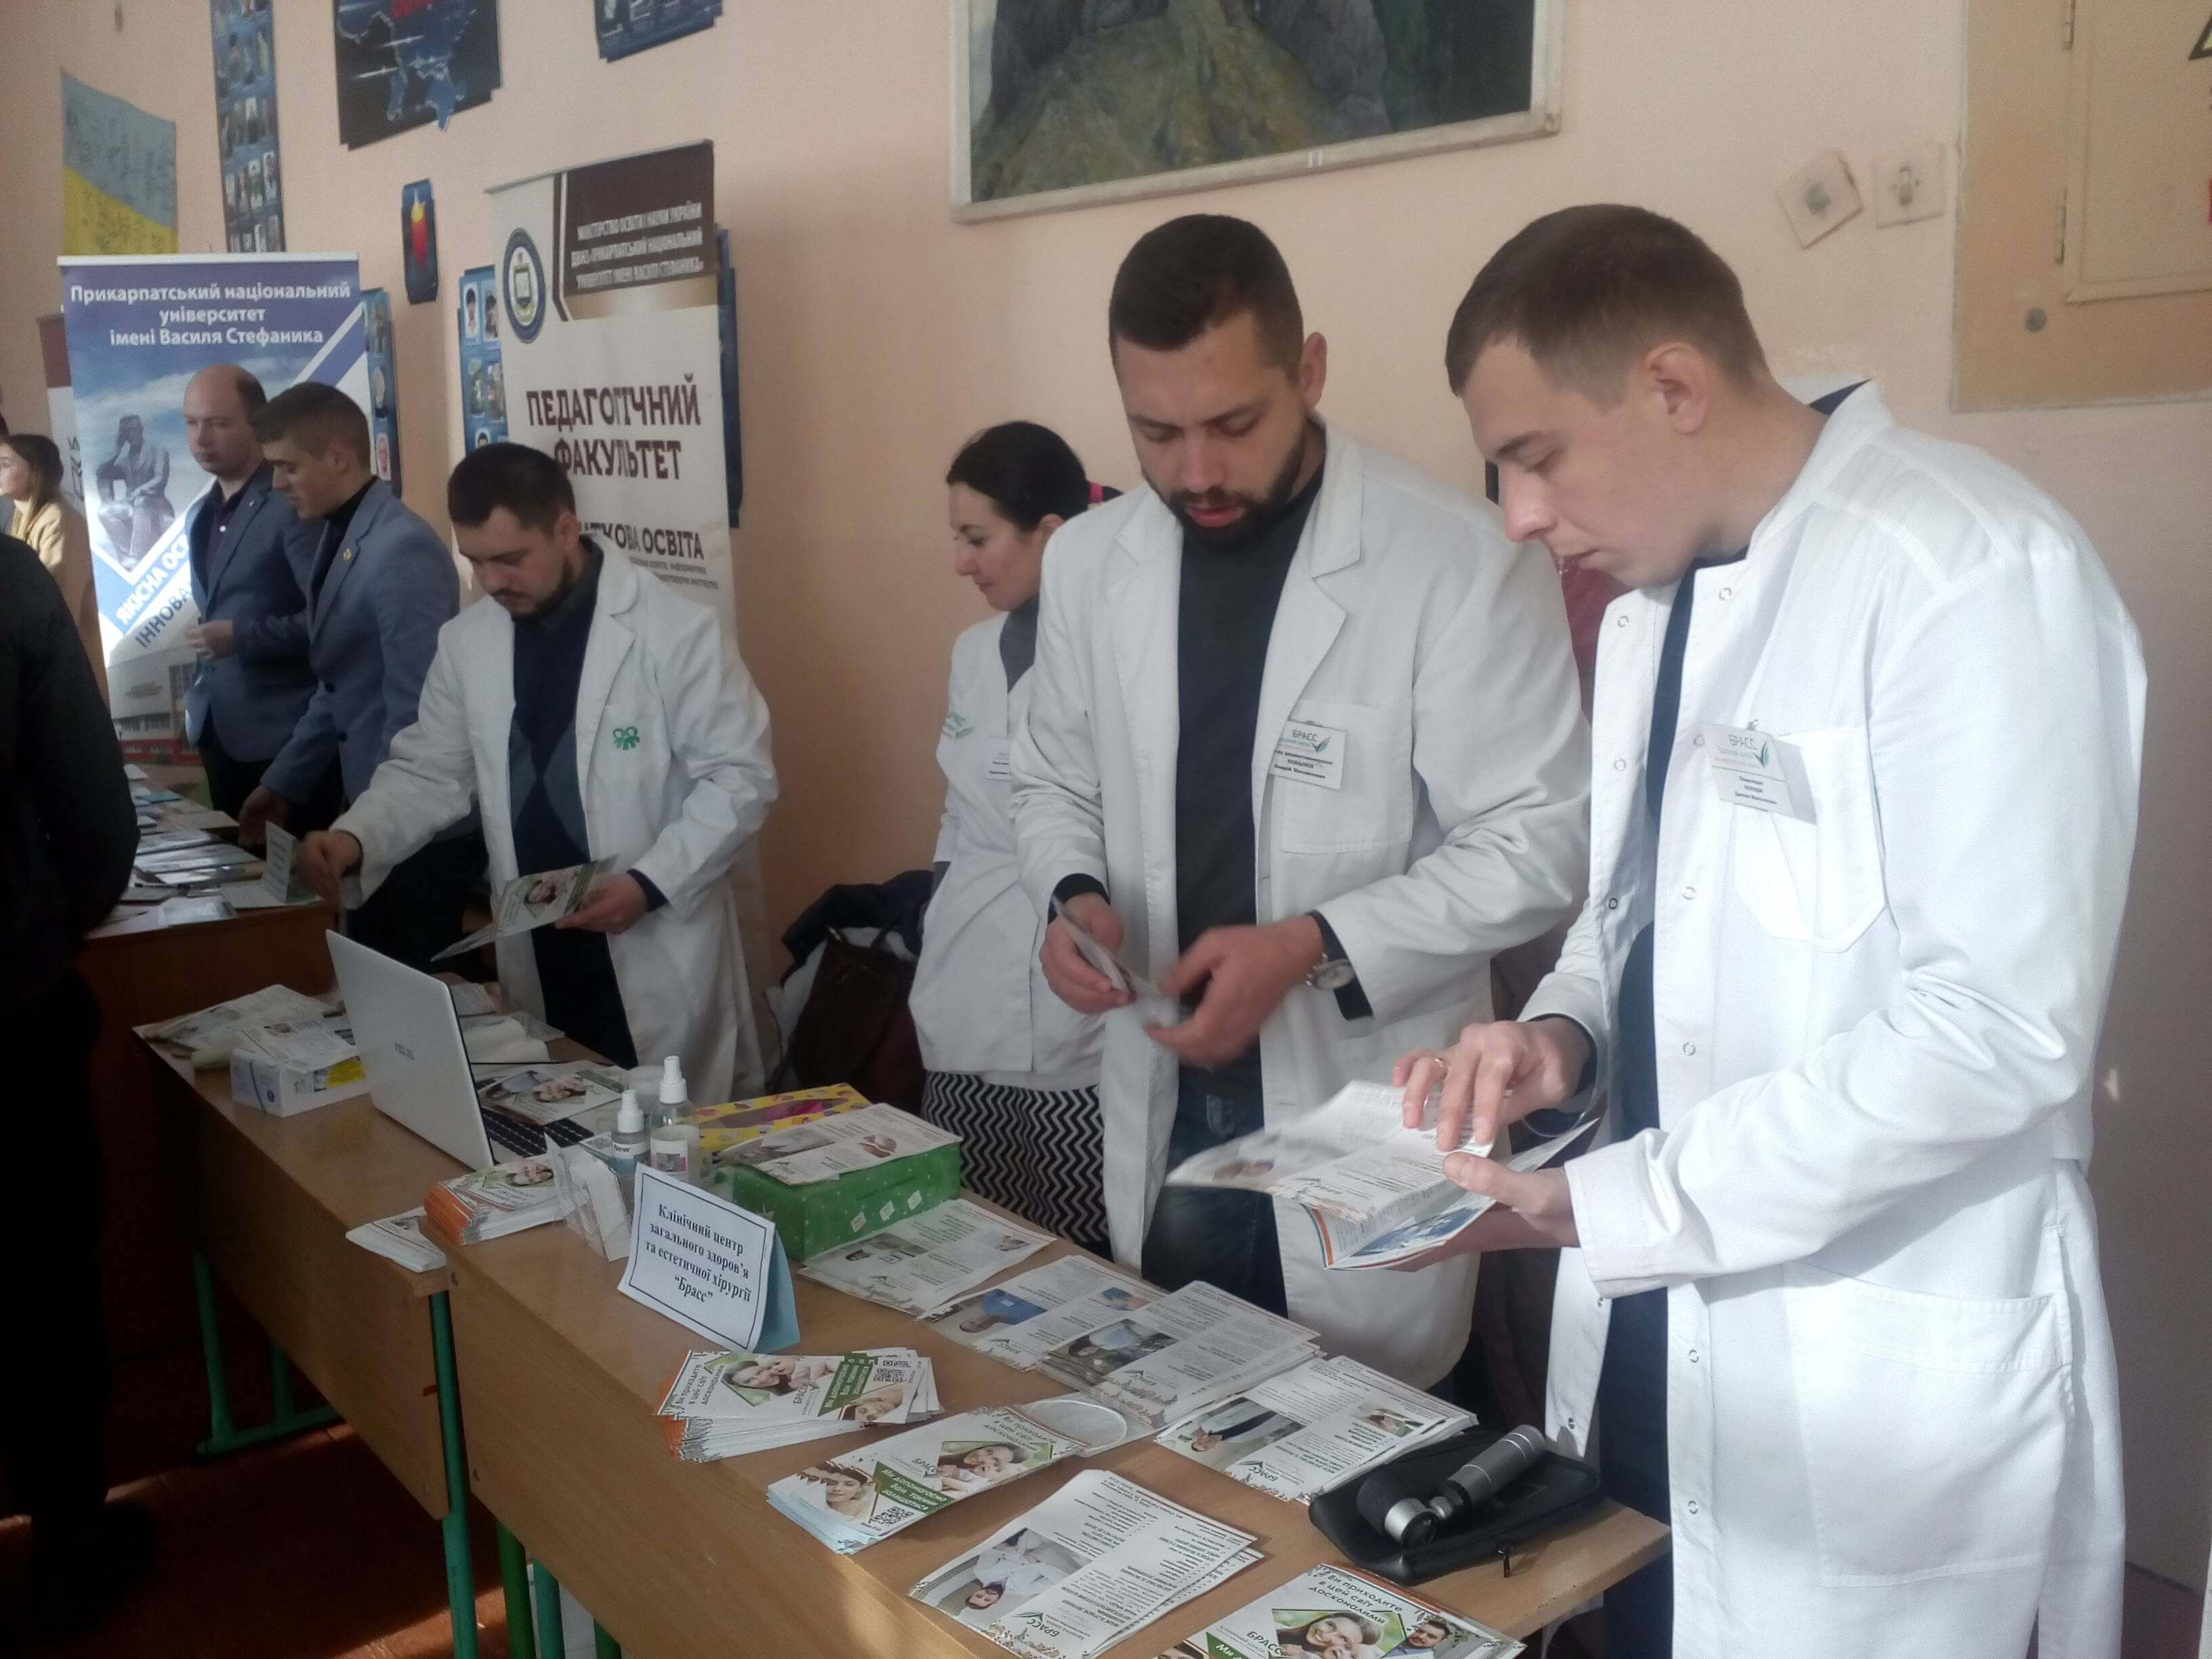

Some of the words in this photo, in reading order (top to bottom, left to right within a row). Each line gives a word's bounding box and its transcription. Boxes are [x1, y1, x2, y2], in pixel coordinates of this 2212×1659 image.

[70, 283, 221, 306] Прикарпатський
[224, 281, 351, 302] національний
[159, 305, 266, 327] університет
[109, 329, 155, 346] імені
[159, 328, 222, 346] Василя
[226, 327, 324, 347] Стефаника
[554, 438, 682, 480] ФАКУЛЬТЕТ
[642, 527, 705, 560] ОСВІТА
[1292, 729, 1318, 743] БРАСС
[650, 1223, 705, 1256] загального
[659, 1204, 711, 1239] Клінічний
[713, 1229, 743, 1255] центр
[645, 1241, 656, 1254] та
[713, 1274, 752, 1303] хірургії
[1309, 1586, 1386, 1624] досконалими
[1326, 1584, 1349, 1597] цей
[1350, 1595, 1374, 1609] світ
[1327, 1574, 1341, 1583] Ви
[1342, 1581, 1403, 1613] приходите
[1027, 1618, 1060, 1637] БРАСС
[1247, 1631, 1286, 1655] БРАСС
